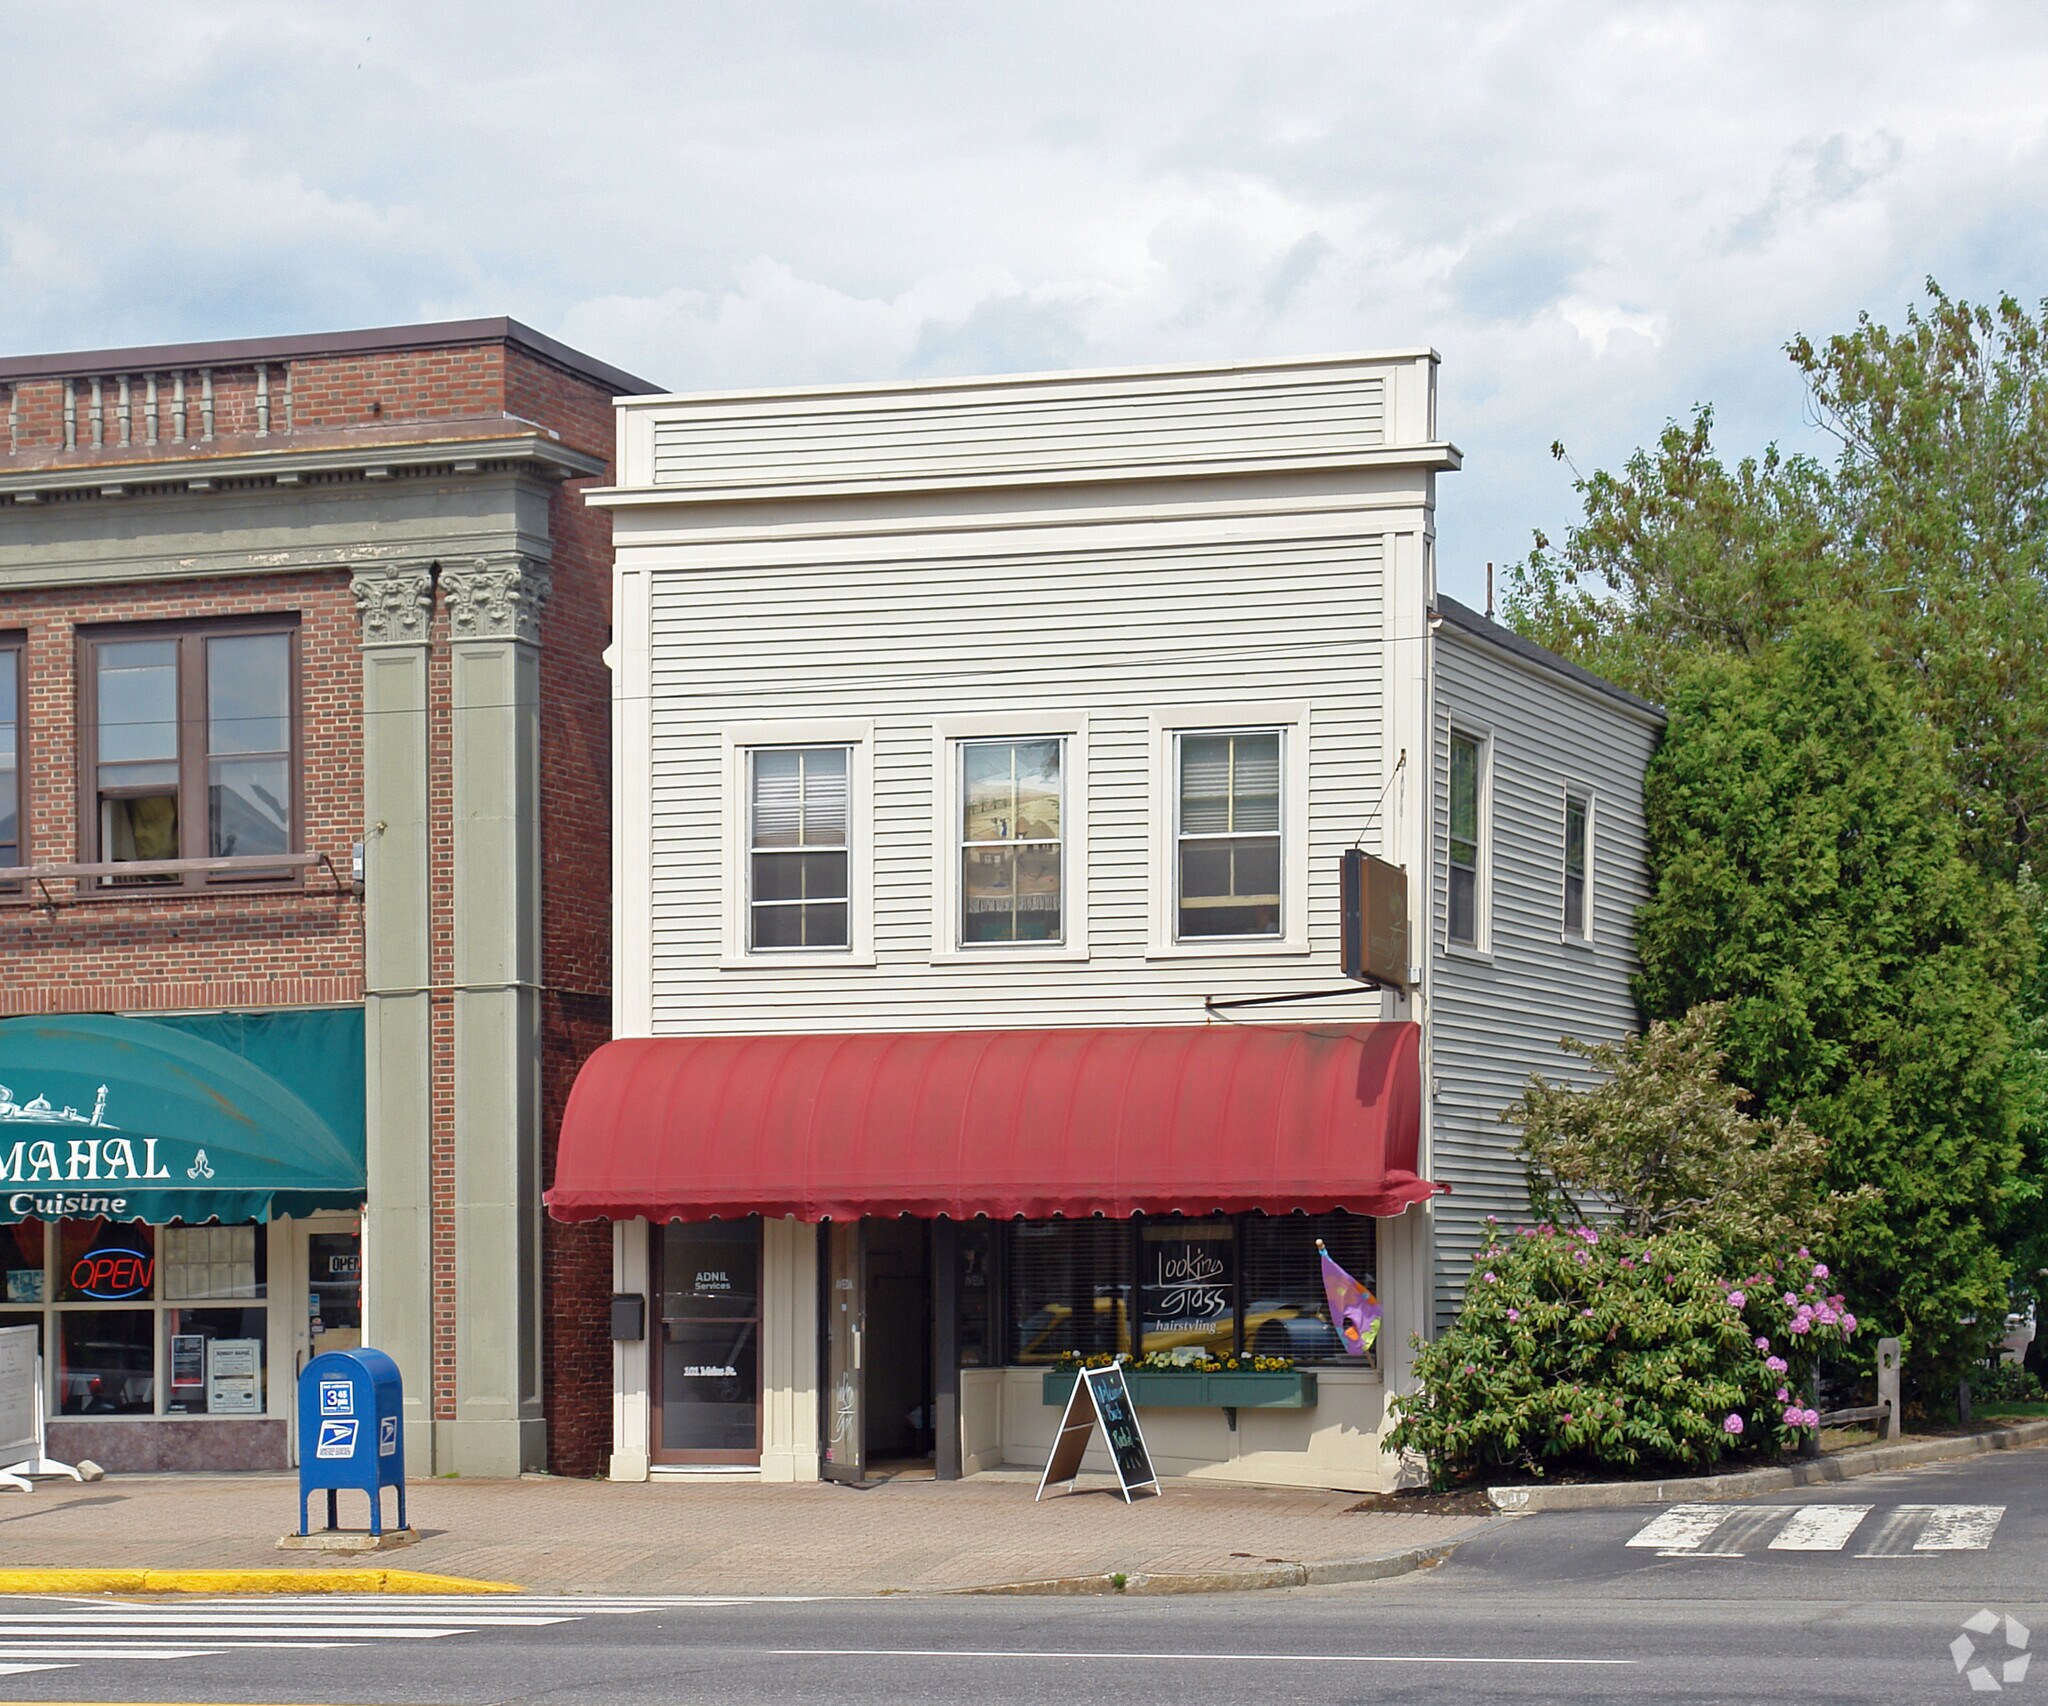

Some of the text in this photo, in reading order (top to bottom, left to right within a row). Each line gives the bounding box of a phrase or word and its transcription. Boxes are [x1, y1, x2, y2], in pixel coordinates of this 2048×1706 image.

[0, 1138, 170, 1182] MAHAL
[9, 1192, 127, 1215] Cuisine
[71, 1257, 155, 1288] OPEN
[332, 1256, 360, 1271] OPEN
[1158, 1244, 1223, 1287] Looking
[694, 1281, 731, 1291] Services
[695, 1271, 729, 1282] ADNIL
[1143, 1286, 1226, 1317] glass
[1155, 1319, 1217, 1335] hairstyling
[327, 1390, 338, 1406] 3
